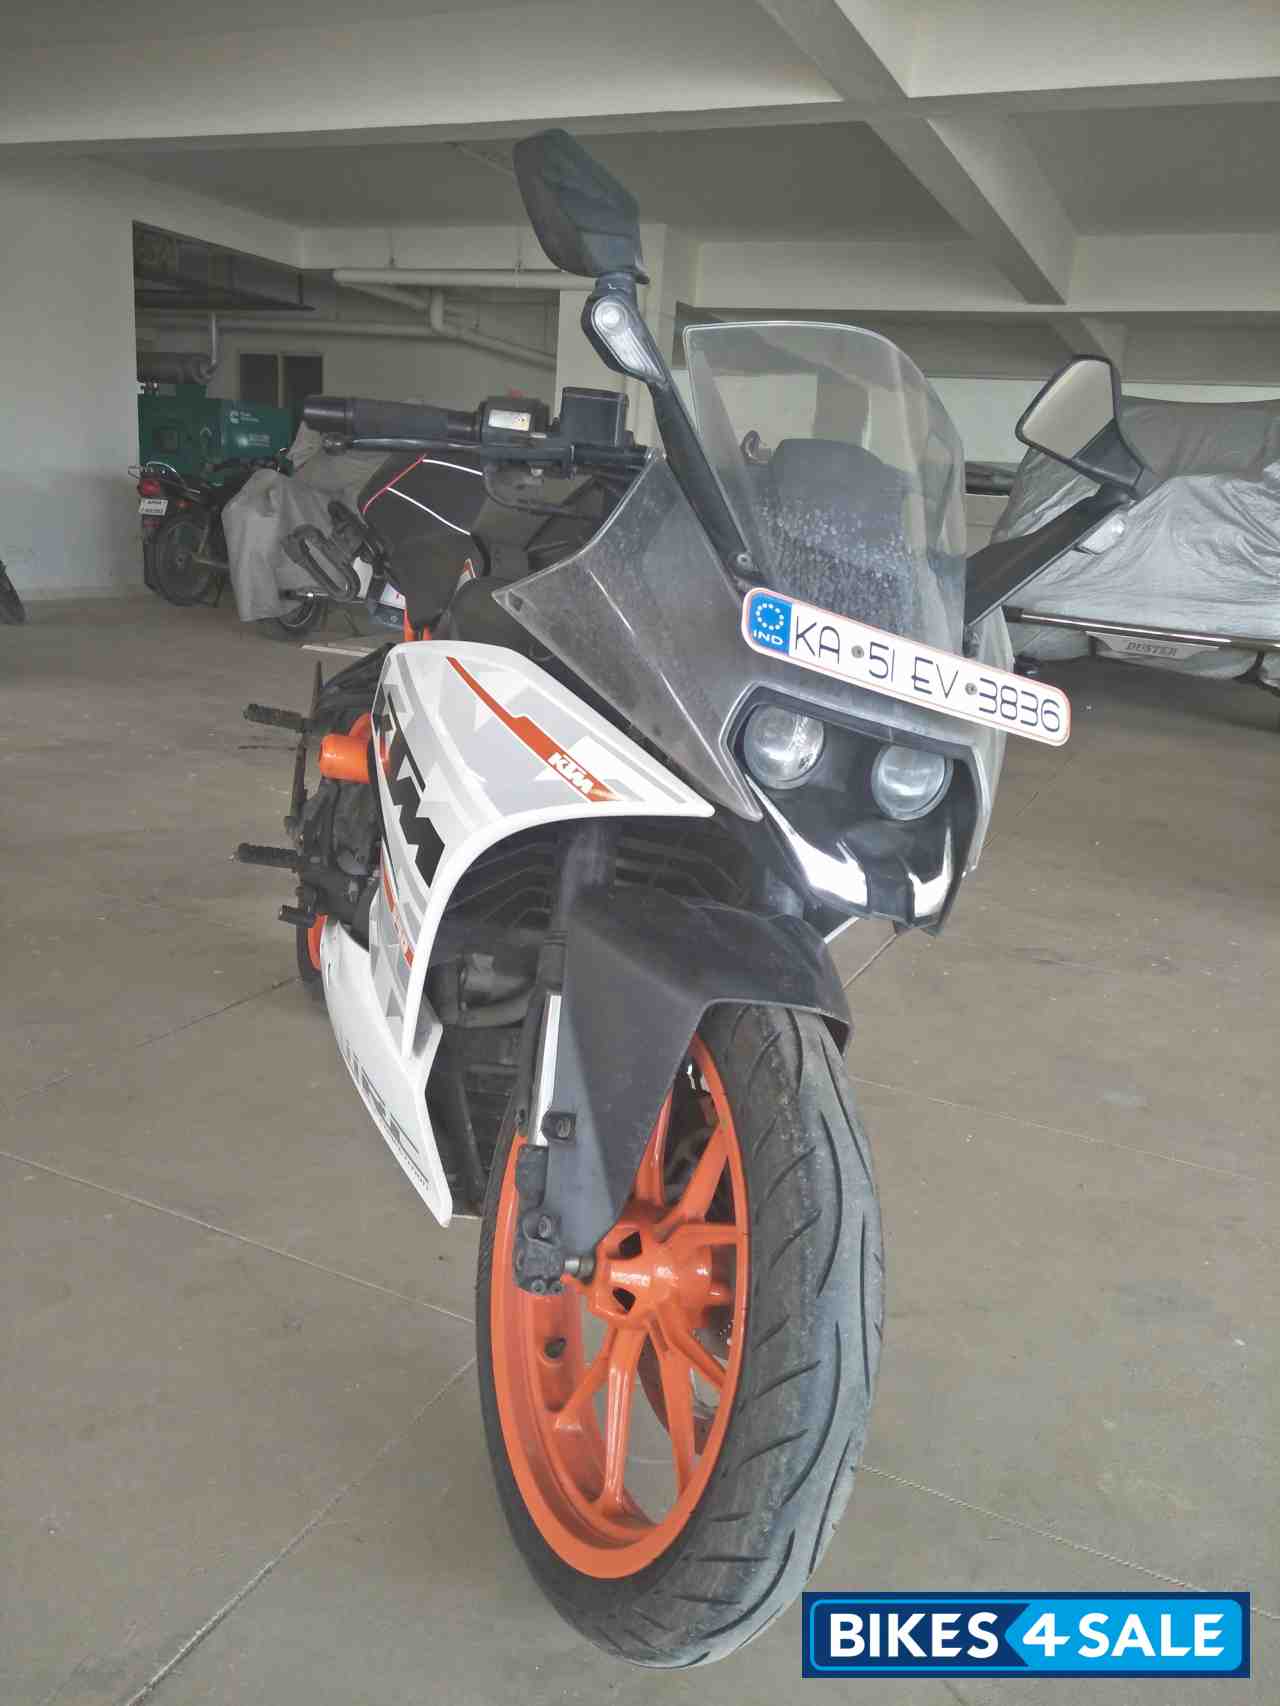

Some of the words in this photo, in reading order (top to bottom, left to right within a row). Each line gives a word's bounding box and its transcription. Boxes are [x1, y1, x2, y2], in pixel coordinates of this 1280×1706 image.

[753, 630, 784, 646] IND
[795, 616, 841, 665] KA
[911, 656, 959, 699] EV
[978, 677, 1061, 733] 3836
[546, 751, 594, 794] KTM
